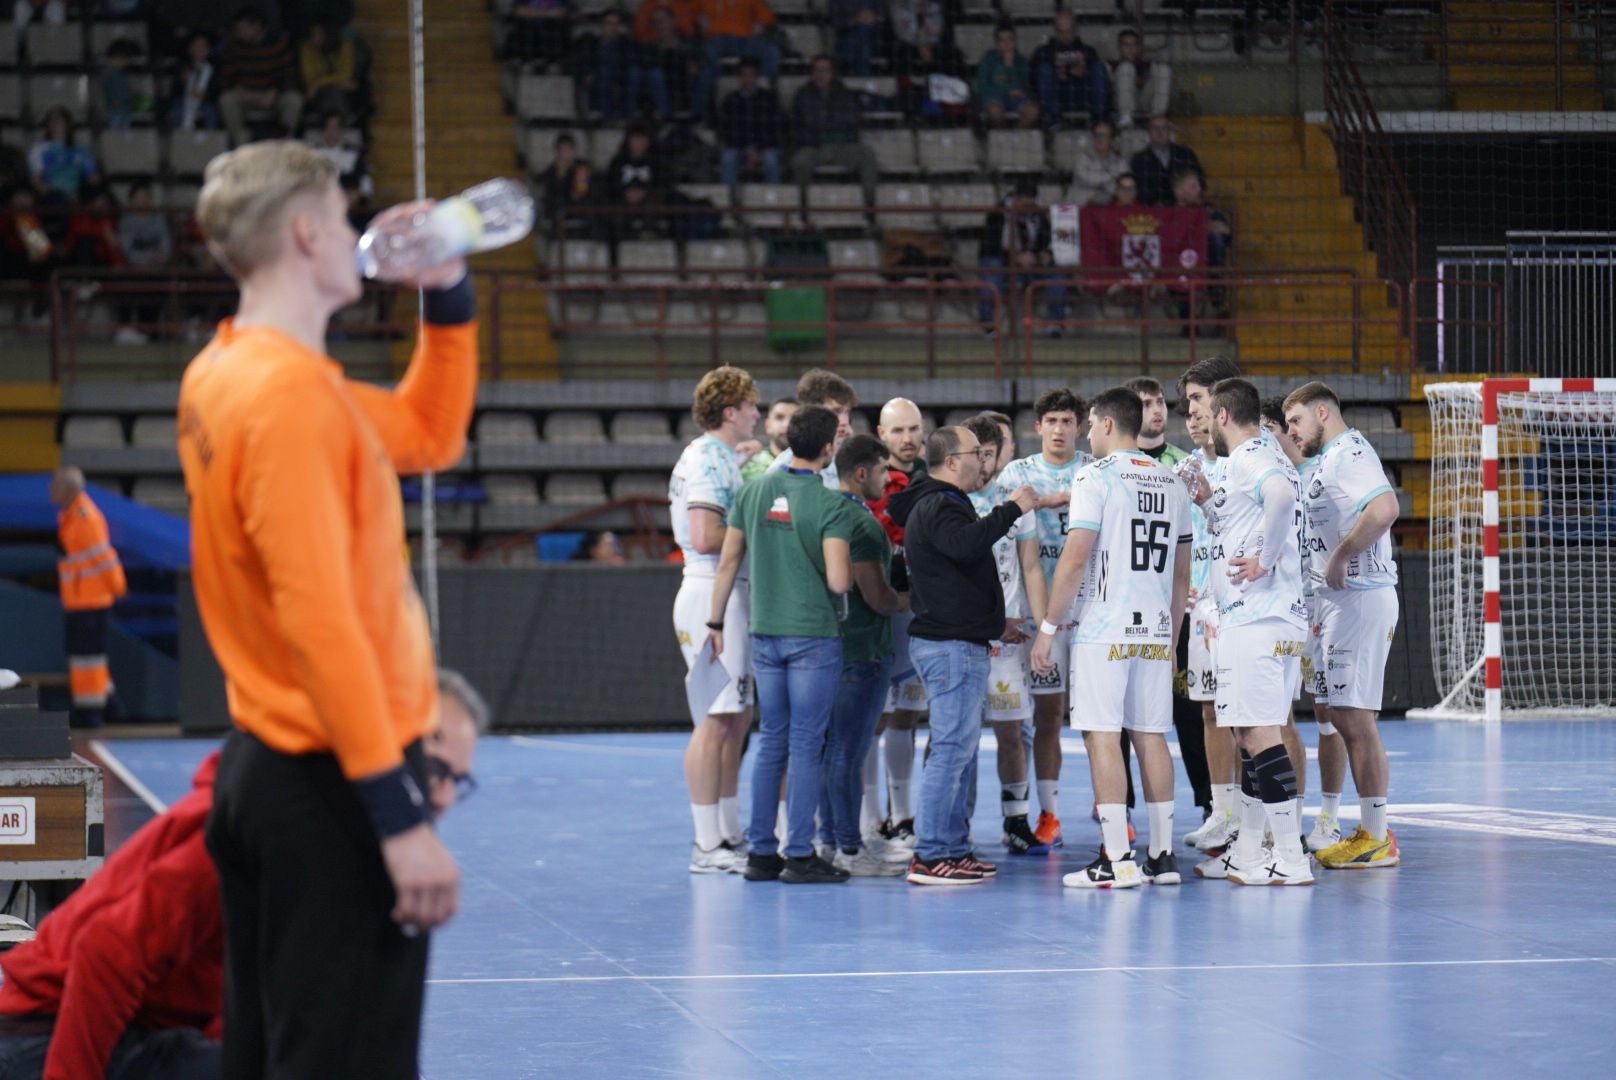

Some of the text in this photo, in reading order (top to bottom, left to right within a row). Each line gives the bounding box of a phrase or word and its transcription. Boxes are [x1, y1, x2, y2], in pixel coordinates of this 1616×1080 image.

[1120, 473, 1152, 482] CASTILLA
[1137, 490, 1165, 514] EDU
[1125, 626, 1149, 635] BELYCAR
[1, 812, 20, 829] AR
